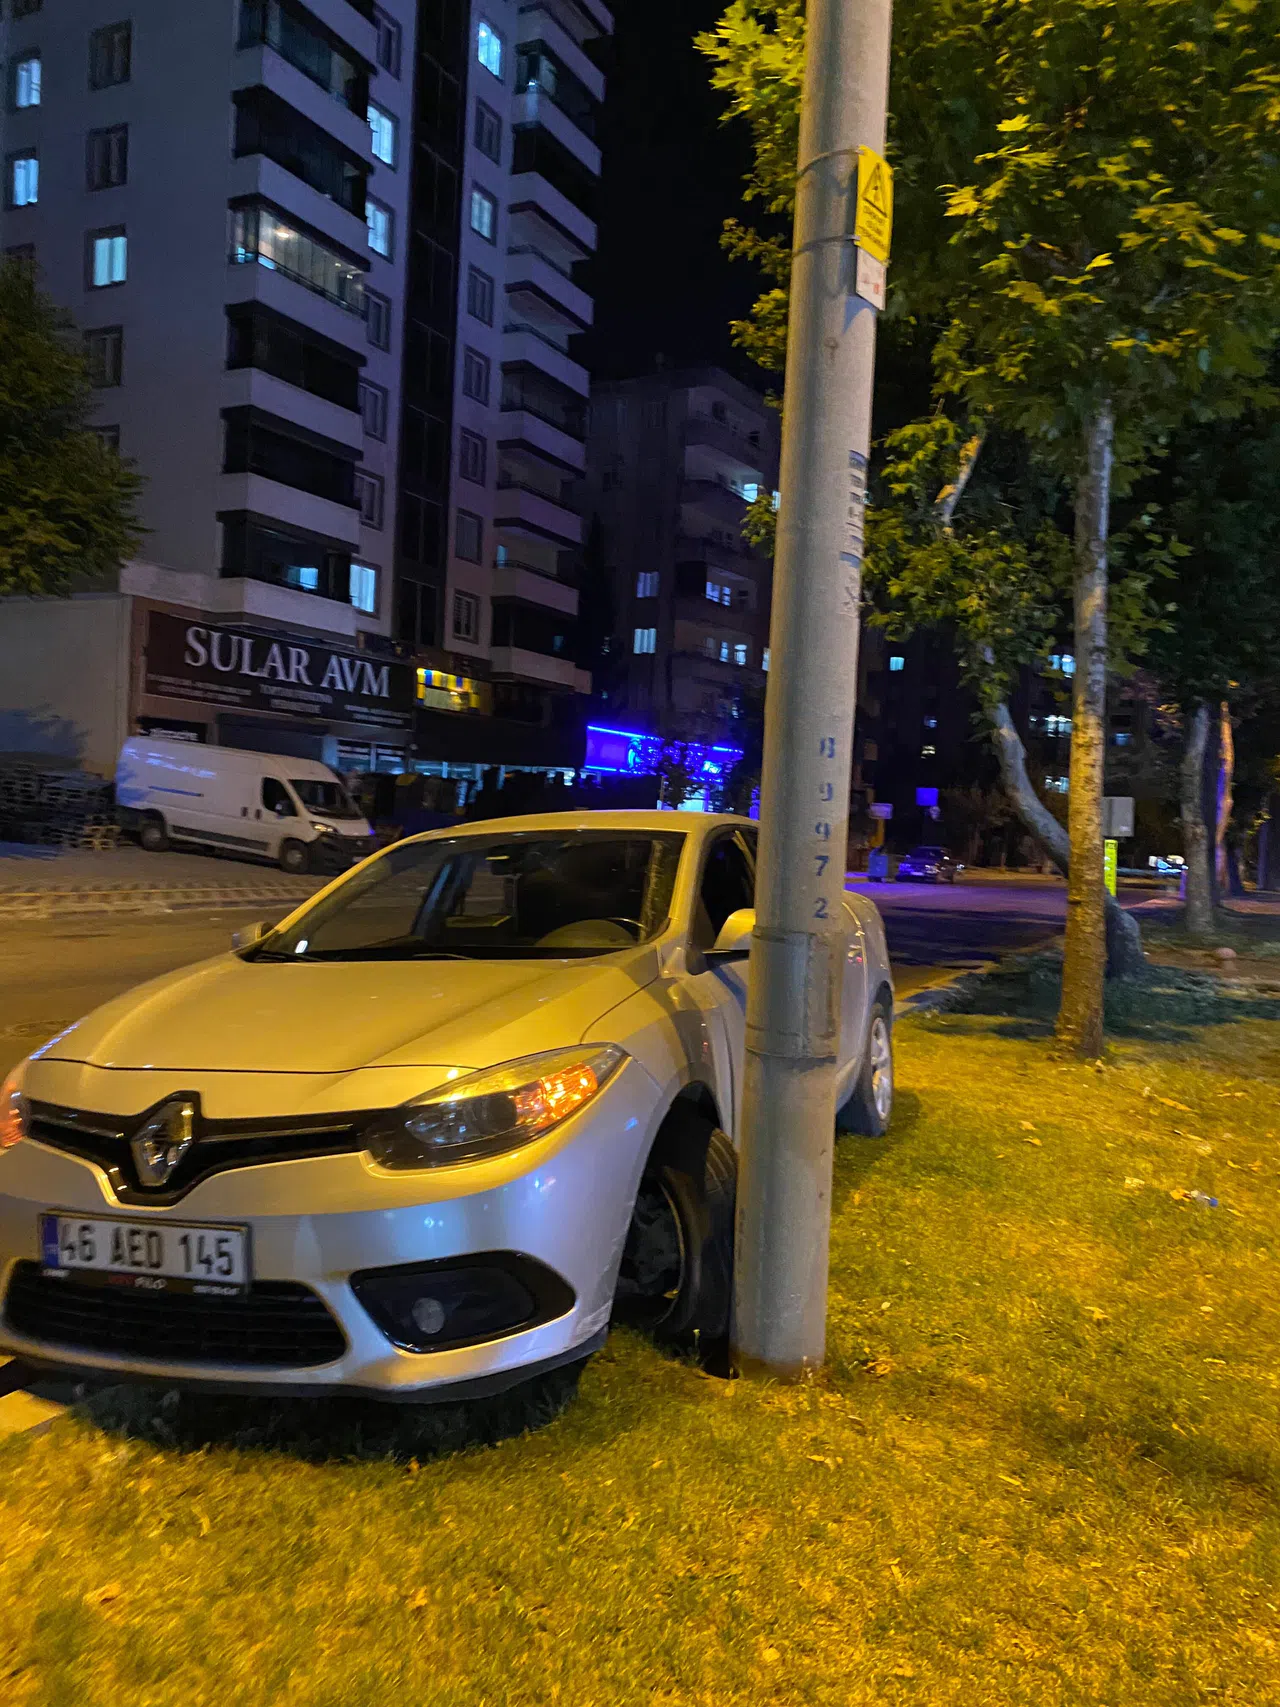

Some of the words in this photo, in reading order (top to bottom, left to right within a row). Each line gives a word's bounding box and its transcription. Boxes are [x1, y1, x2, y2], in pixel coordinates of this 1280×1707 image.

[184, 626, 313, 686] SULAR
[320, 654, 390, 698] AVM
[61, 1223, 96, 1262] 46
[180, 1234, 234, 1276] 145
